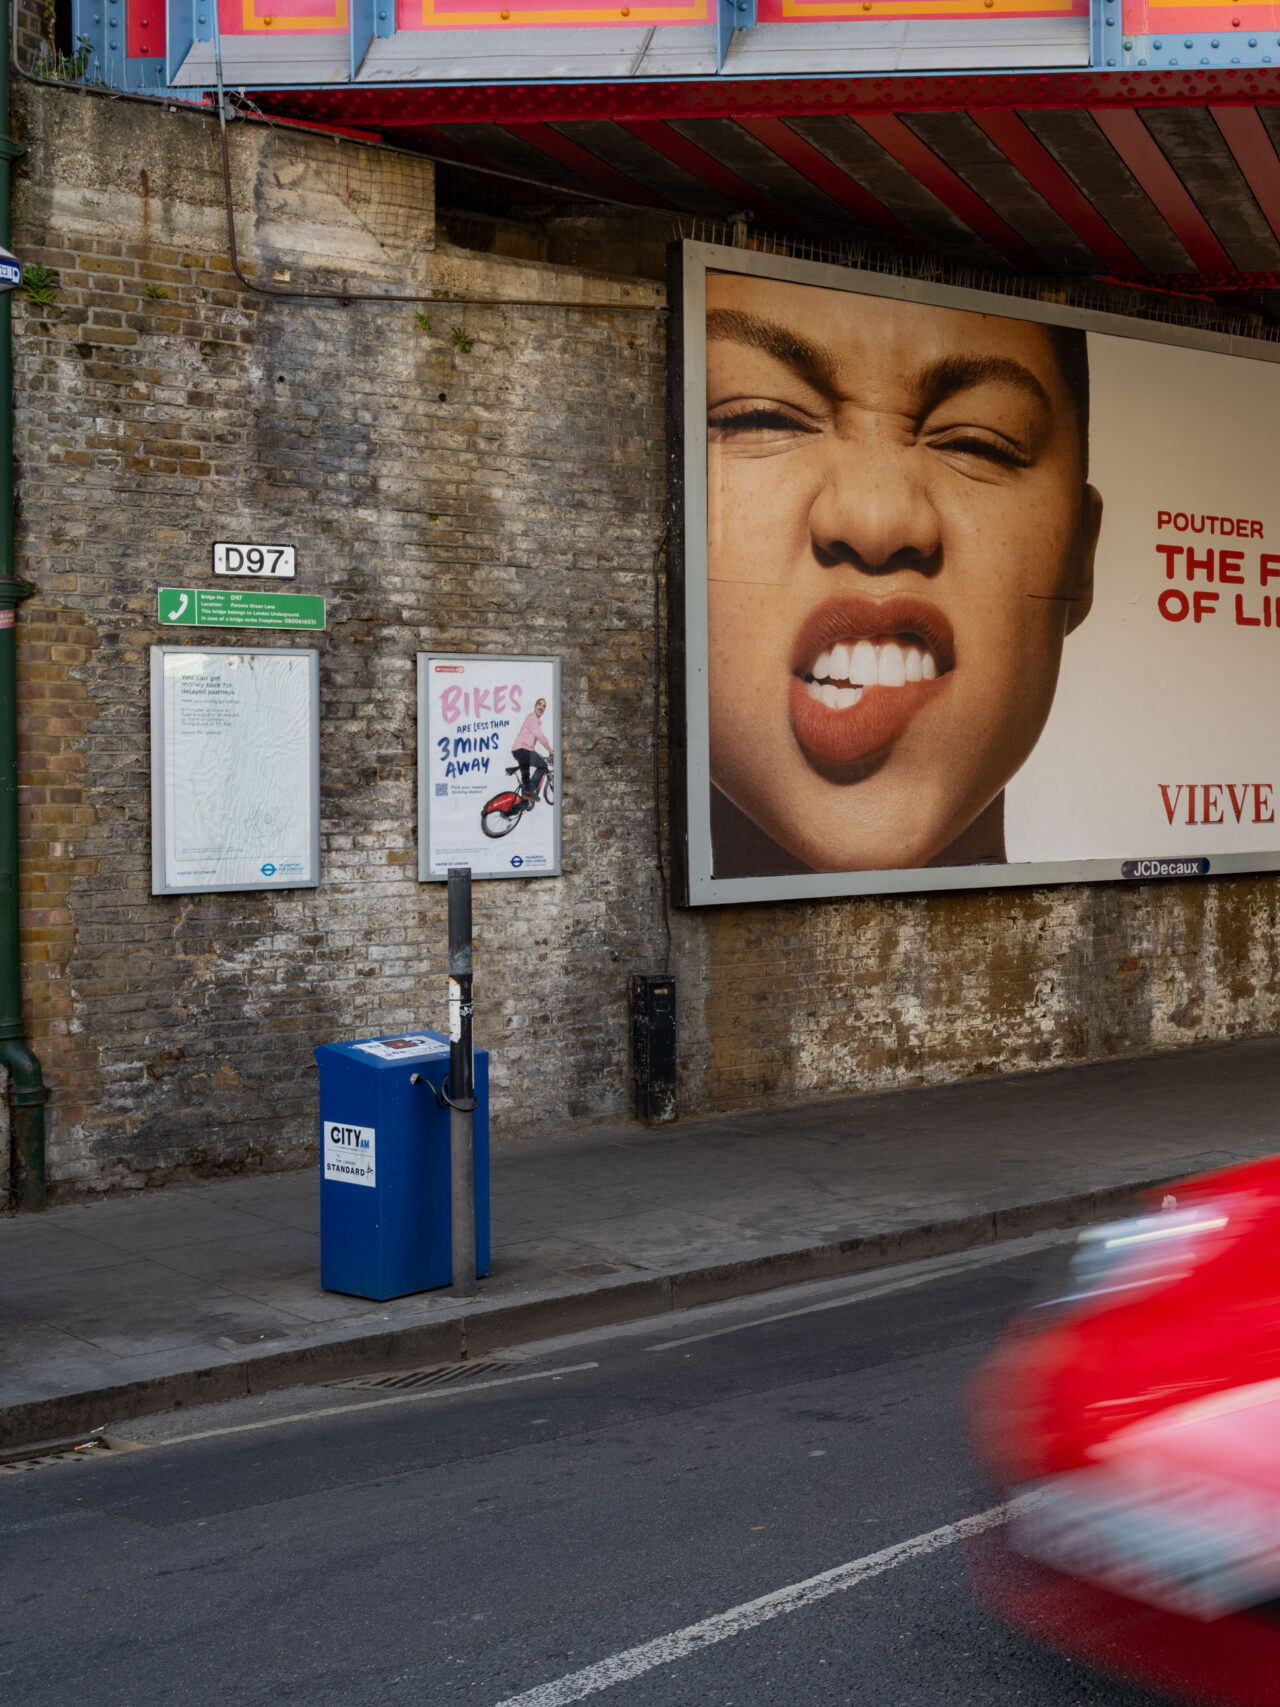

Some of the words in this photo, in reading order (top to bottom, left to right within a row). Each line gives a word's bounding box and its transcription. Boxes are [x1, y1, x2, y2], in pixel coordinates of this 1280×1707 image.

[1157, 510, 1265, 540] POUTDER
[225, 547, 284, 573] D97
[1155, 543, 1246, 585] THE
[1157, 588, 1220, 624] OF
[440, 684, 522, 724] BIKES
[457, 724, 471, 734] ARE
[473, 722, 489, 731] LESS
[490, 720, 510, 729] THAN
[437, 737, 450, 761] 3
[454, 732, 499, 758] MINS
[445, 756, 490, 779] AWAY
[1158, 784, 1274, 825] VIEVE
[1133, 859, 1199, 876] JCDecaux
[331, 1126, 361, 1147] CITY
[360, 1139, 369, 1149] AM
[327, 1163, 365, 1176] STANDARD
